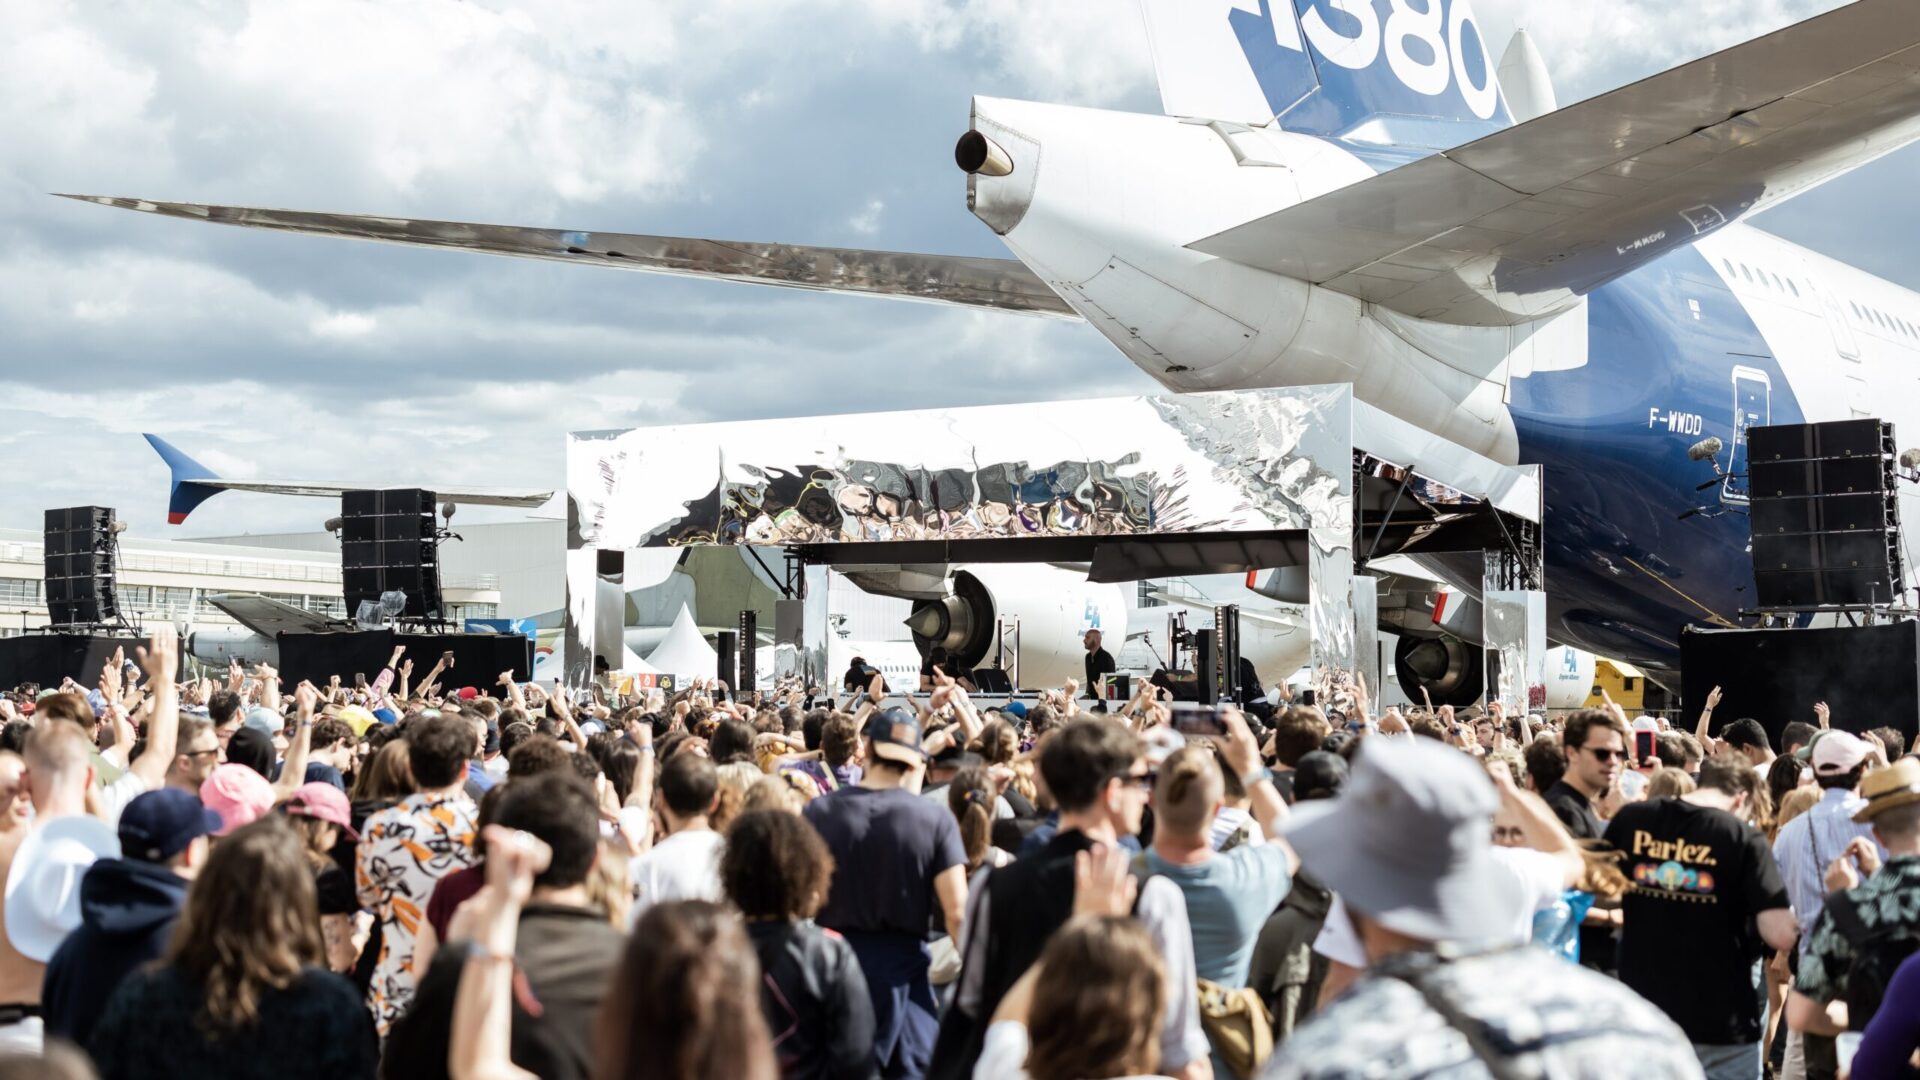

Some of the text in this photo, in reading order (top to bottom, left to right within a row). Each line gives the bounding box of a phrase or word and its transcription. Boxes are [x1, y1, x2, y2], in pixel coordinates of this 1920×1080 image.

[1231, 0, 1498, 120] 380
[1649, 407, 1702, 436] F-WWDD
[1632, 829, 1717, 866] Parlez.
